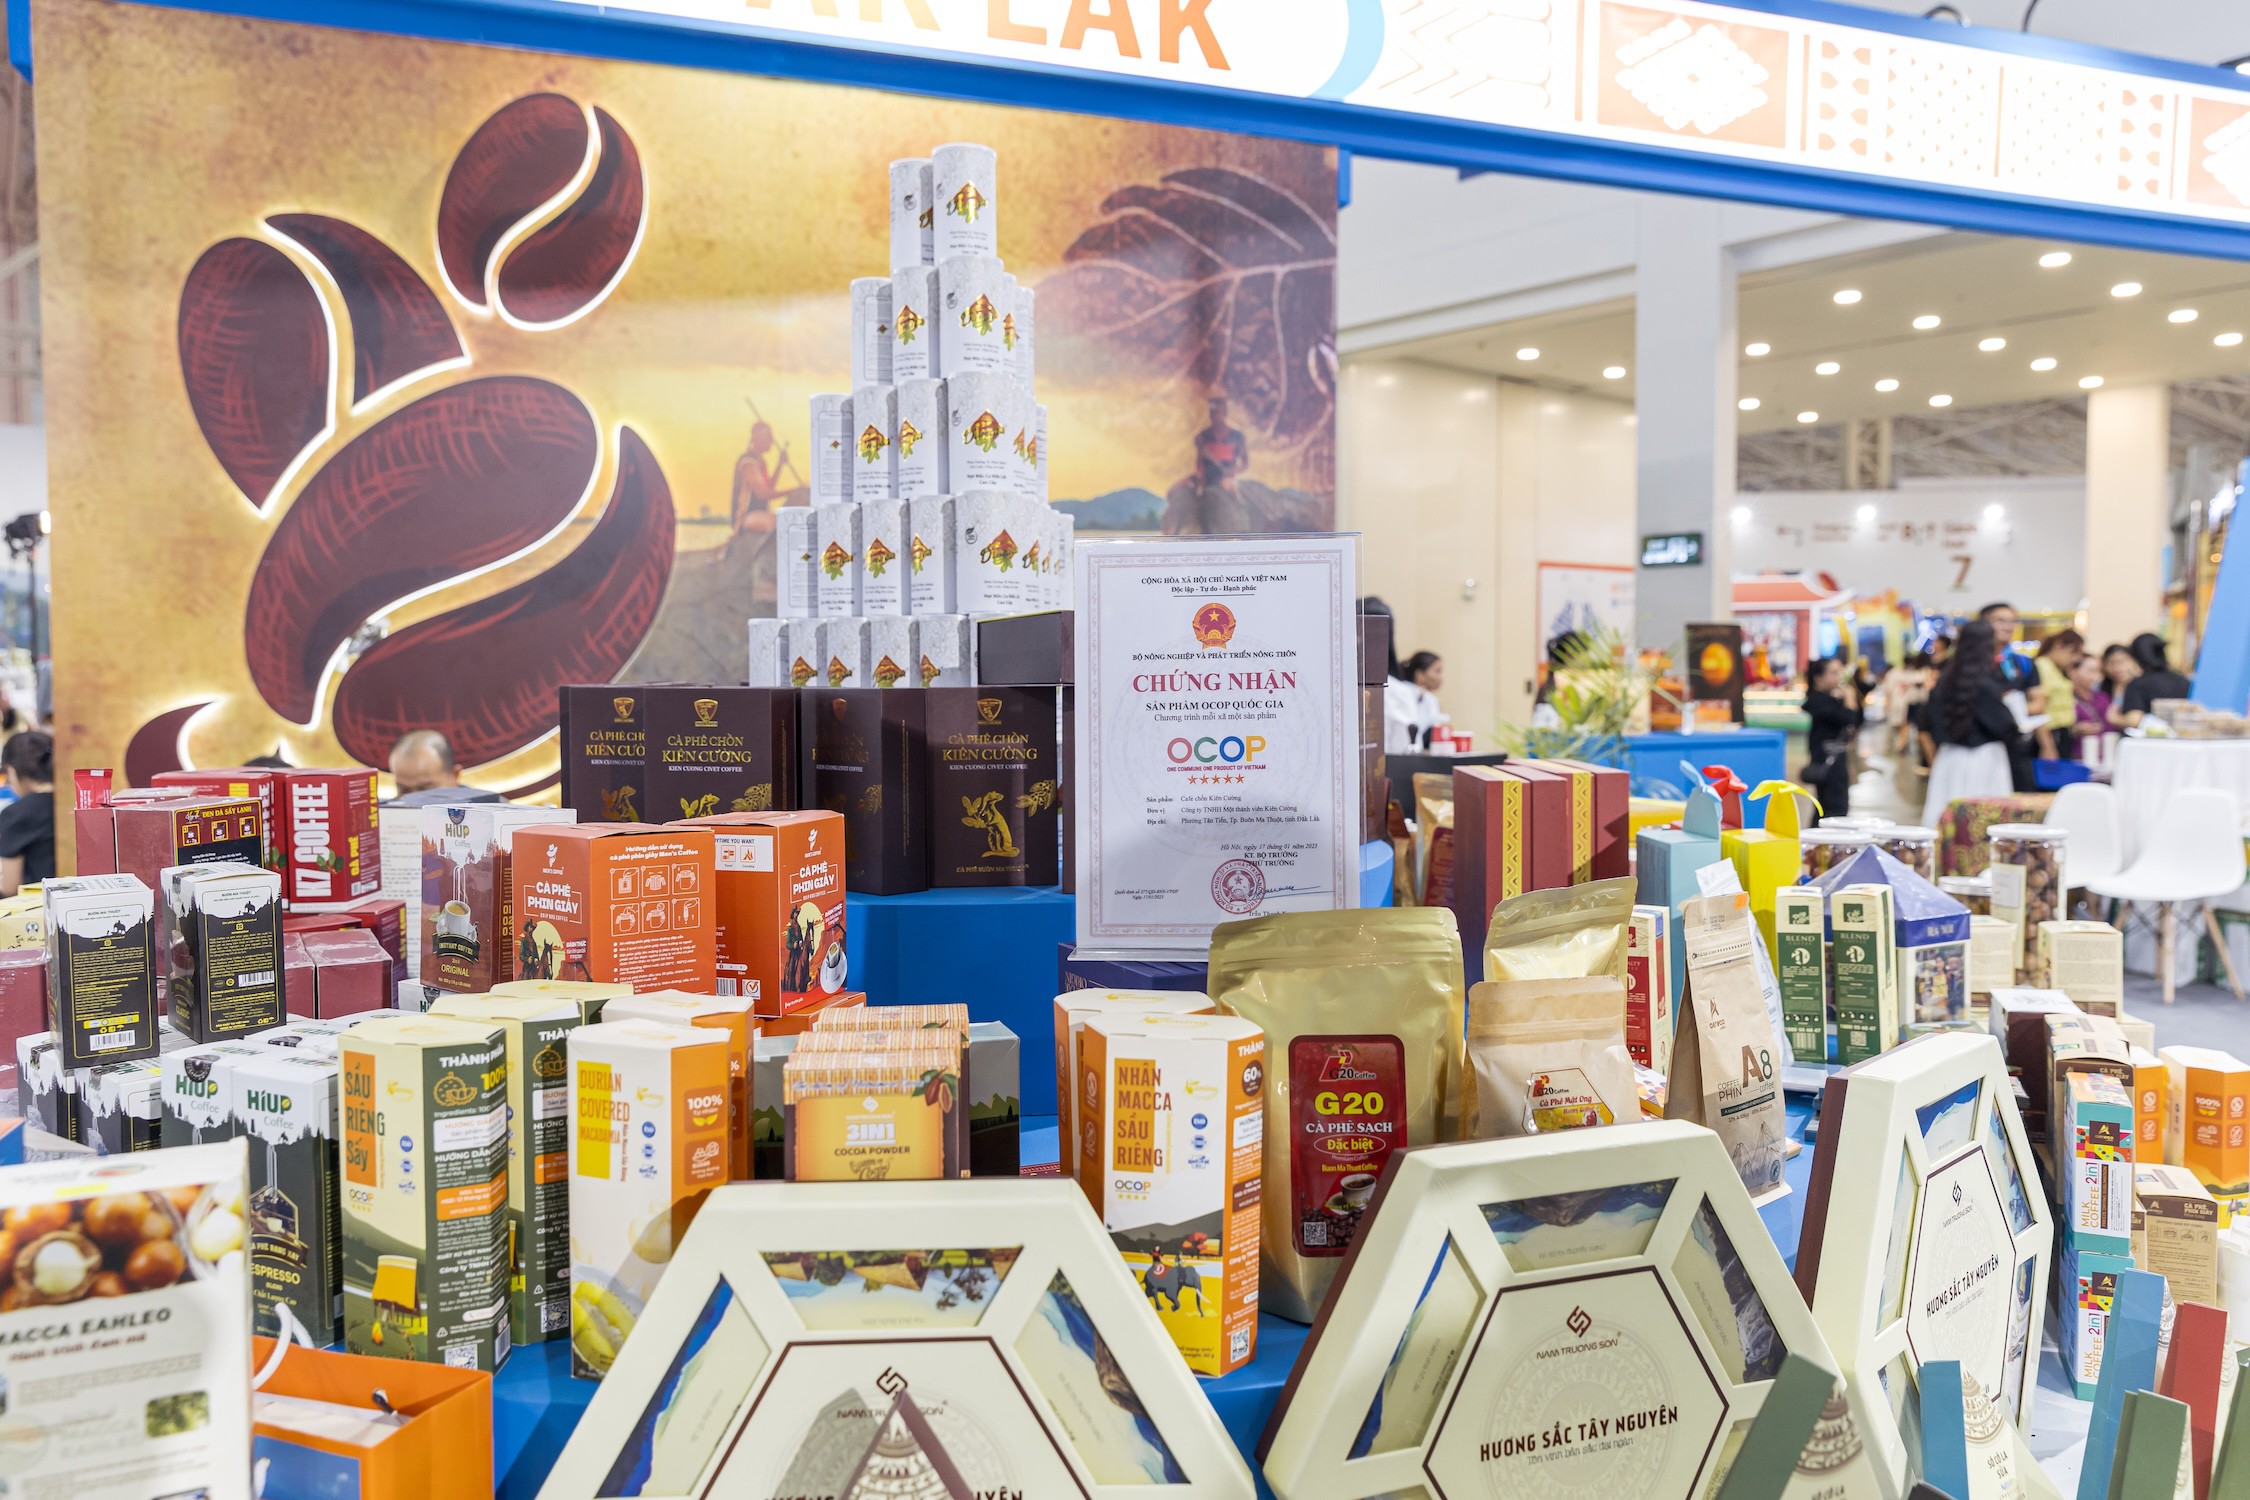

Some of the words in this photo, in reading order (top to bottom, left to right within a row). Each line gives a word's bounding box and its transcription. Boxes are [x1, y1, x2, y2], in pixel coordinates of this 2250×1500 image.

[1164, 576, 1180, 584] HÒA
[1193, 576, 1207, 585] HỘI
[1251, 574, 1268, 583] VIỆT
[1951, 556, 1971, 588] 7
[1223, 585, 1241, 593] Hạnh
[1132, 653, 1143, 661] BỘ
[1166, 652, 1195, 661] NGHIỆP
[1208, 650, 1227, 659] PHÁT
[1252, 650, 1275, 658] NÔNG
[1133, 669, 1222, 692] CHỨNG
[1228, 669, 1297, 694] NHẬN
[1201, 701, 1231, 710] OCOP
[1265, 699, 1284, 708] GIA
[589, 730, 602, 741] CÀ
[667, 734, 684, 746] CÀ
[685, 733, 707, 747] PHÊ
[949, 734, 965, 744] CÀ
[967, 731, 990, 744] PHÊ
[698, 748, 752, 763] CƯỜNG
[943, 747, 979, 761] KIÊN
[981, 746, 1038, 761] CƯỜNG
[1167, 736, 1266, 763] OCOP
[292, 783, 330, 863] COFFEE
[454, 839, 471, 848] Coffee
[799, 865, 811, 878] CÀ
[811, 860, 828, 874] PHÊ
[536, 880, 551, 894] CÀ
[552, 883, 571, 897] PHÊ
[793, 880, 815, 895] PHIN
[814, 874, 835, 889] GIẤY
[527, 896, 554, 911] PHIN
[554, 897, 579, 914] GIẤY
[457, 943, 474, 954] COFFEE
[440, 964, 470, 978] ORIGINAL
[438, 1052, 490, 1068] THÀNH
[1742, 1044, 1773, 1088] A8
[345, 1061, 371, 1098] SẦU
[579, 1069, 622, 1092] DURIAN
[1118, 1061, 1162, 1087] NHÂN
[1329, 1068, 1354, 1080] G20
[1354, 1072, 1377, 1080] Coffee
[1718, 1079, 1740, 1091] COFFEE
[1719, 1087, 1742, 1101] PHIN
[1759, 1081, 1775, 1093] coffee
[191, 1100, 219, 1114] Coffee
[687, 1094, 723, 1110] 100%
[1118, 1090, 1172, 1111] MACCA
[1539, 1099, 1549, 1107] Cà
[1550, 1098, 1563, 1106] Phê
[1579, 1095, 1592, 1103] Ong
[579, 1097, 630, 1122] COVERED
[264, 1116, 294, 1130] Coffee
[346, 1102, 385, 1136] RIÊNG
[1117, 1111, 1148, 1140] SẦU
[1306, 1120, 1325, 1134] CÀ
[1328, 1119, 1353, 1134] PHÊ
[1357, 1121, 1393, 1135] SẠCH
[579, 1126, 621, 1144] MACADAMIA
[847, 1123, 895, 1140] 3IN1
[834, 1148, 867, 1157] COCOA
[869, 1146, 910, 1155] POWDER
[1327, 1136, 1349, 1153] Đặc
[1351, 1136, 1374, 1153] biệt
[346, 1137, 368, 1172] Sấy
[1117, 1142, 1163, 1167] RIÊNG
[1361, 1163, 1378, 1171] Coffee
[2086, 1161, 2099, 1184] 2in1
[1115, 1180, 1152, 1192] OCOP
[350, 1188, 374, 1202] OCOP
[2081, 1201, 2090, 1227] MILK
[2090, 1186, 2100, 1228] COFFEE
[2183, 1202, 2193, 1210] CÀ
[1949, 1278, 1962, 1304] SẮC
[1963, 1269, 1974, 1292] TÂY
[1976, 1254, 1999, 1280] NGUYÊN
[81, 1308, 172, 1335] EAHLEO
[2088, 1312, 2101, 1335] 2in1
[1536, 1349, 1560, 1360] NAM
[1561, 1342, 1598, 1356] TRUONG
[1598, 1338, 1619, 1350] SON
[2084, 1352, 2093, 1378] MILK
[1480, 1432, 1536, 1462] HƯƠNG
[1542, 1420, 1572, 1449] SẮC
[1578, 1416, 1609, 1440] TÂY
[1615, 1404, 1678, 1433] NGUYÊN
